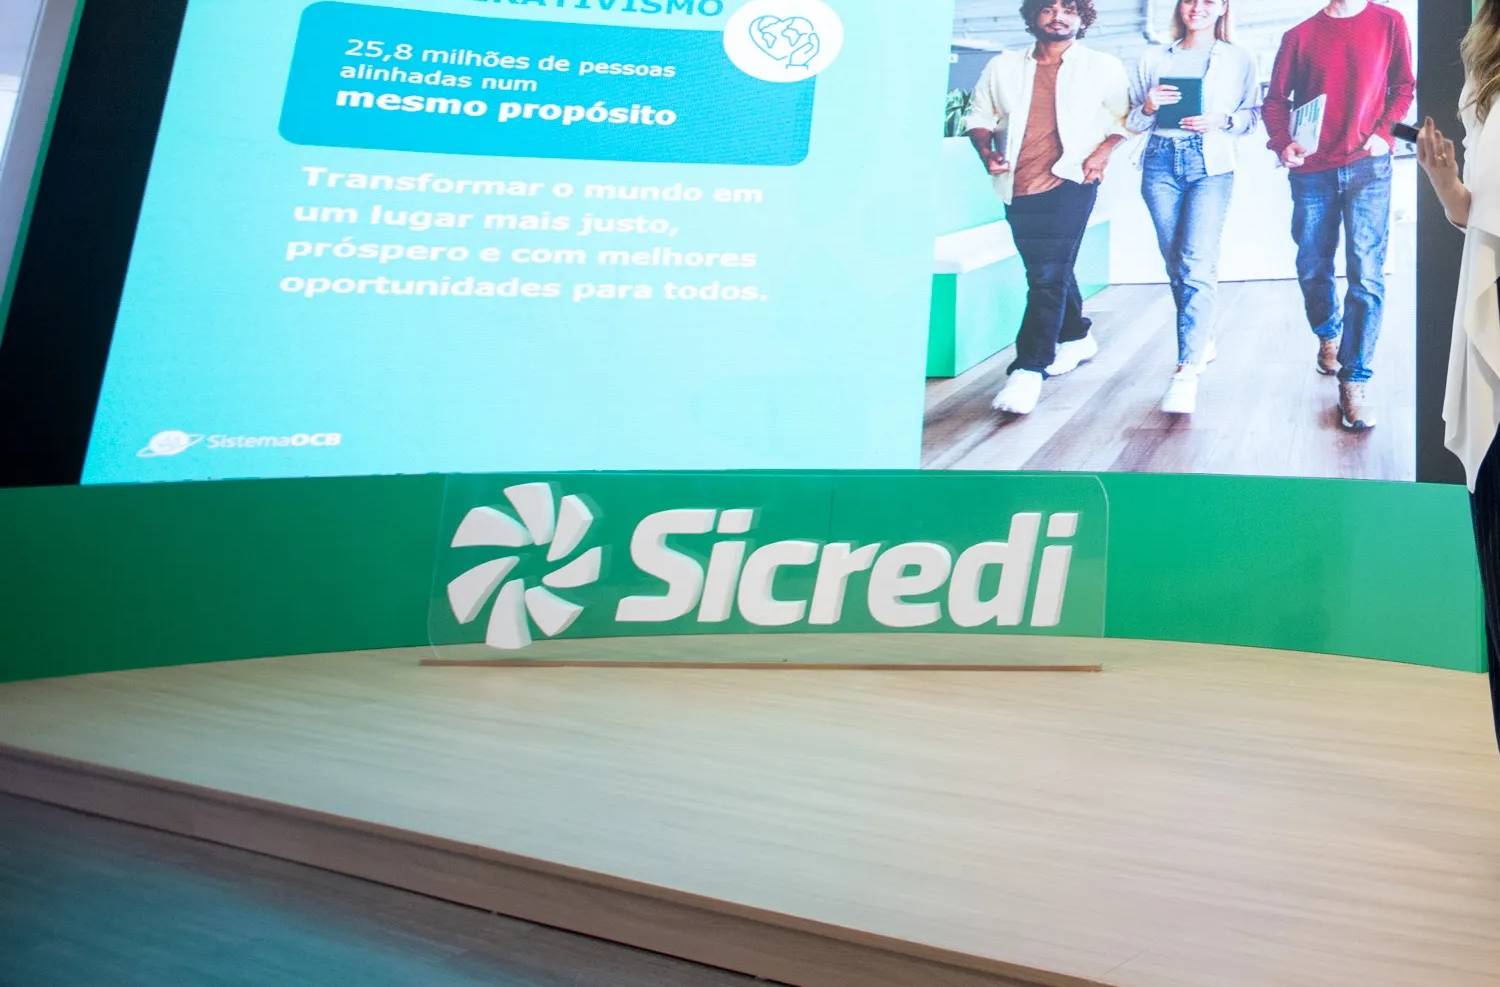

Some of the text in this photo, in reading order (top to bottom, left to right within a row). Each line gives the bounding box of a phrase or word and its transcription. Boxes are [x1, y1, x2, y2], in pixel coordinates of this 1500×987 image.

[344, 38, 677, 78] 25,8 milhões de pessoas
[340, 63, 538, 93] alinhadas num
[335, 89, 678, 127] mesmo propósito
[301, 166, 764, 203] Transformar o mundo em
[293, 204, 680, 238] um lugar mais justo,
[285, 236, 758, 268] próspero e com melhores
[279, 275, 768, 303] oportunidades para todos.
[614, 507, 1081, 628] Sicredi
